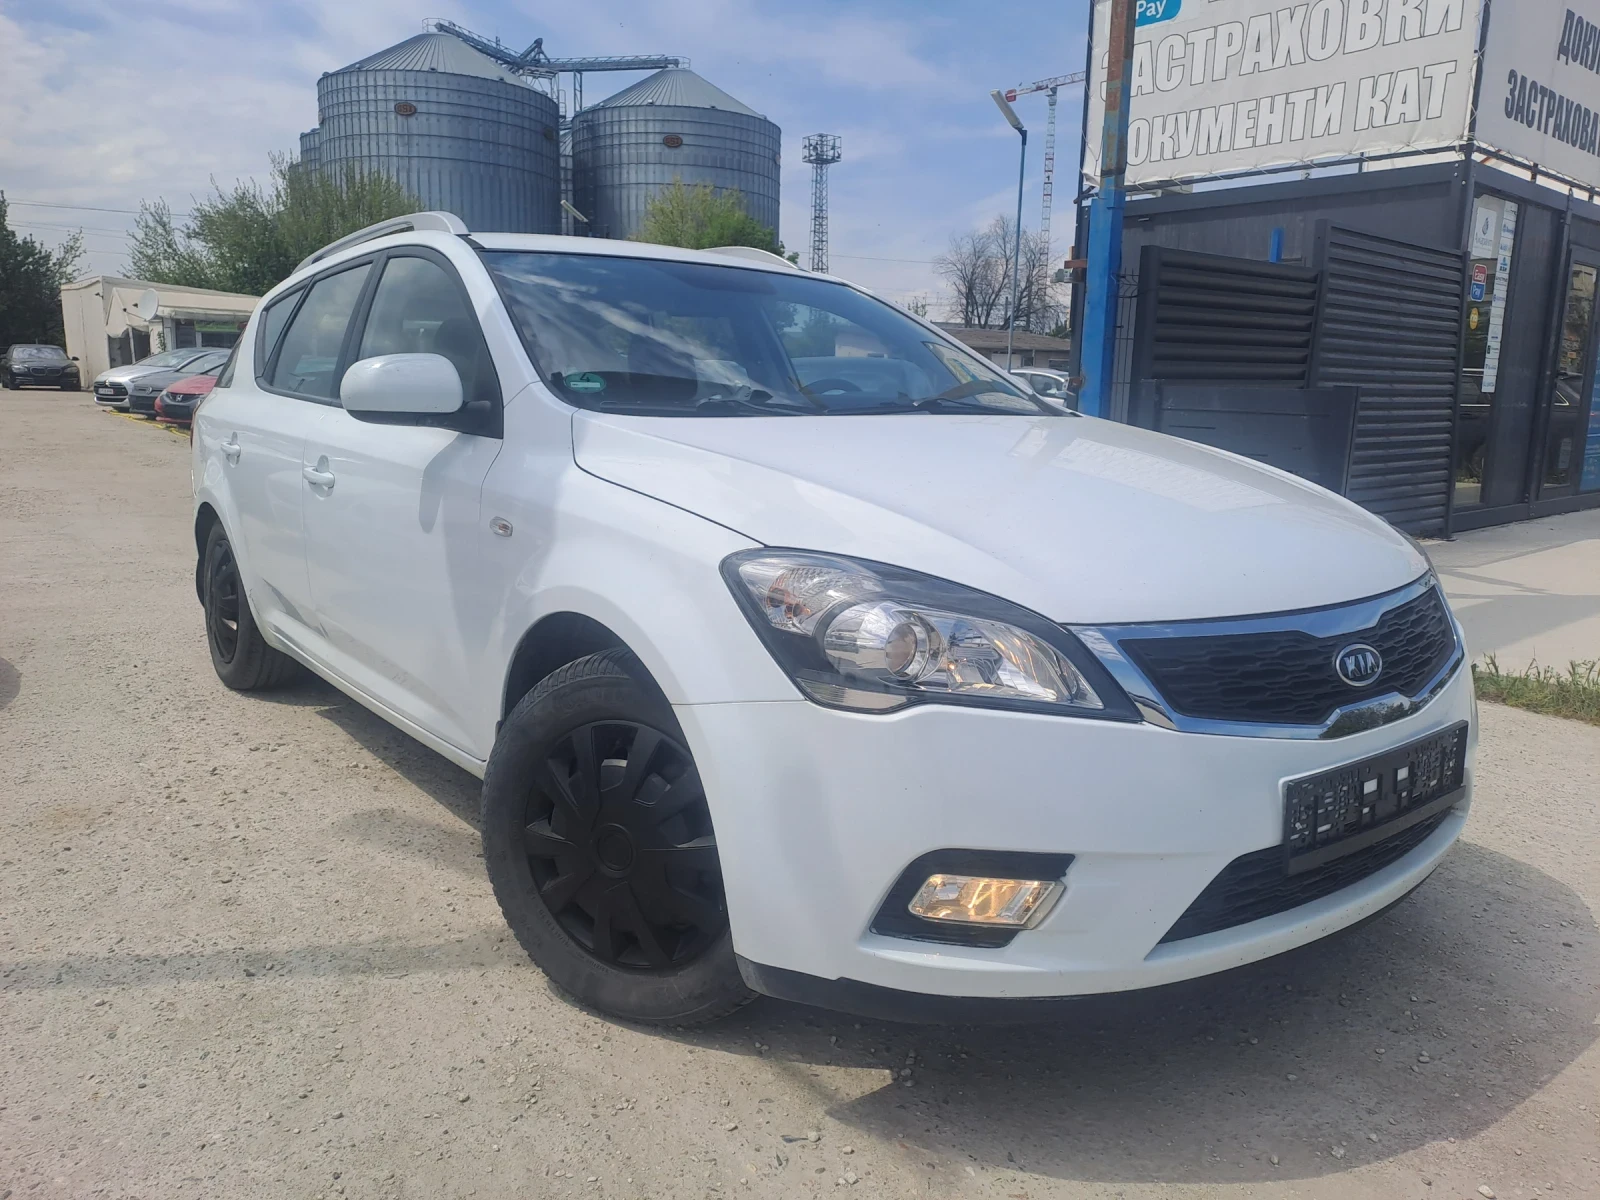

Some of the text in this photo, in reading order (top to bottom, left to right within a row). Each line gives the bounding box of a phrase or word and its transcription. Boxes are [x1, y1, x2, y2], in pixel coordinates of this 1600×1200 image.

[1136, 0, 1167, 18] Pay
[1100, 0, 1465, 103] АСТРАХОВКИ
[1557, 8, 1600, 77] ДОКУ
[1094, 60, 1457, 176] ОКУМЕНТИ КАТ
[1505, 69, 1600, 158] ЗАСТРАХОВА
[1472, 284, 1482, 298] Pay
[1474, 269, 1485, 283] Easy
[1343, 652, 1378, 679] KIA
